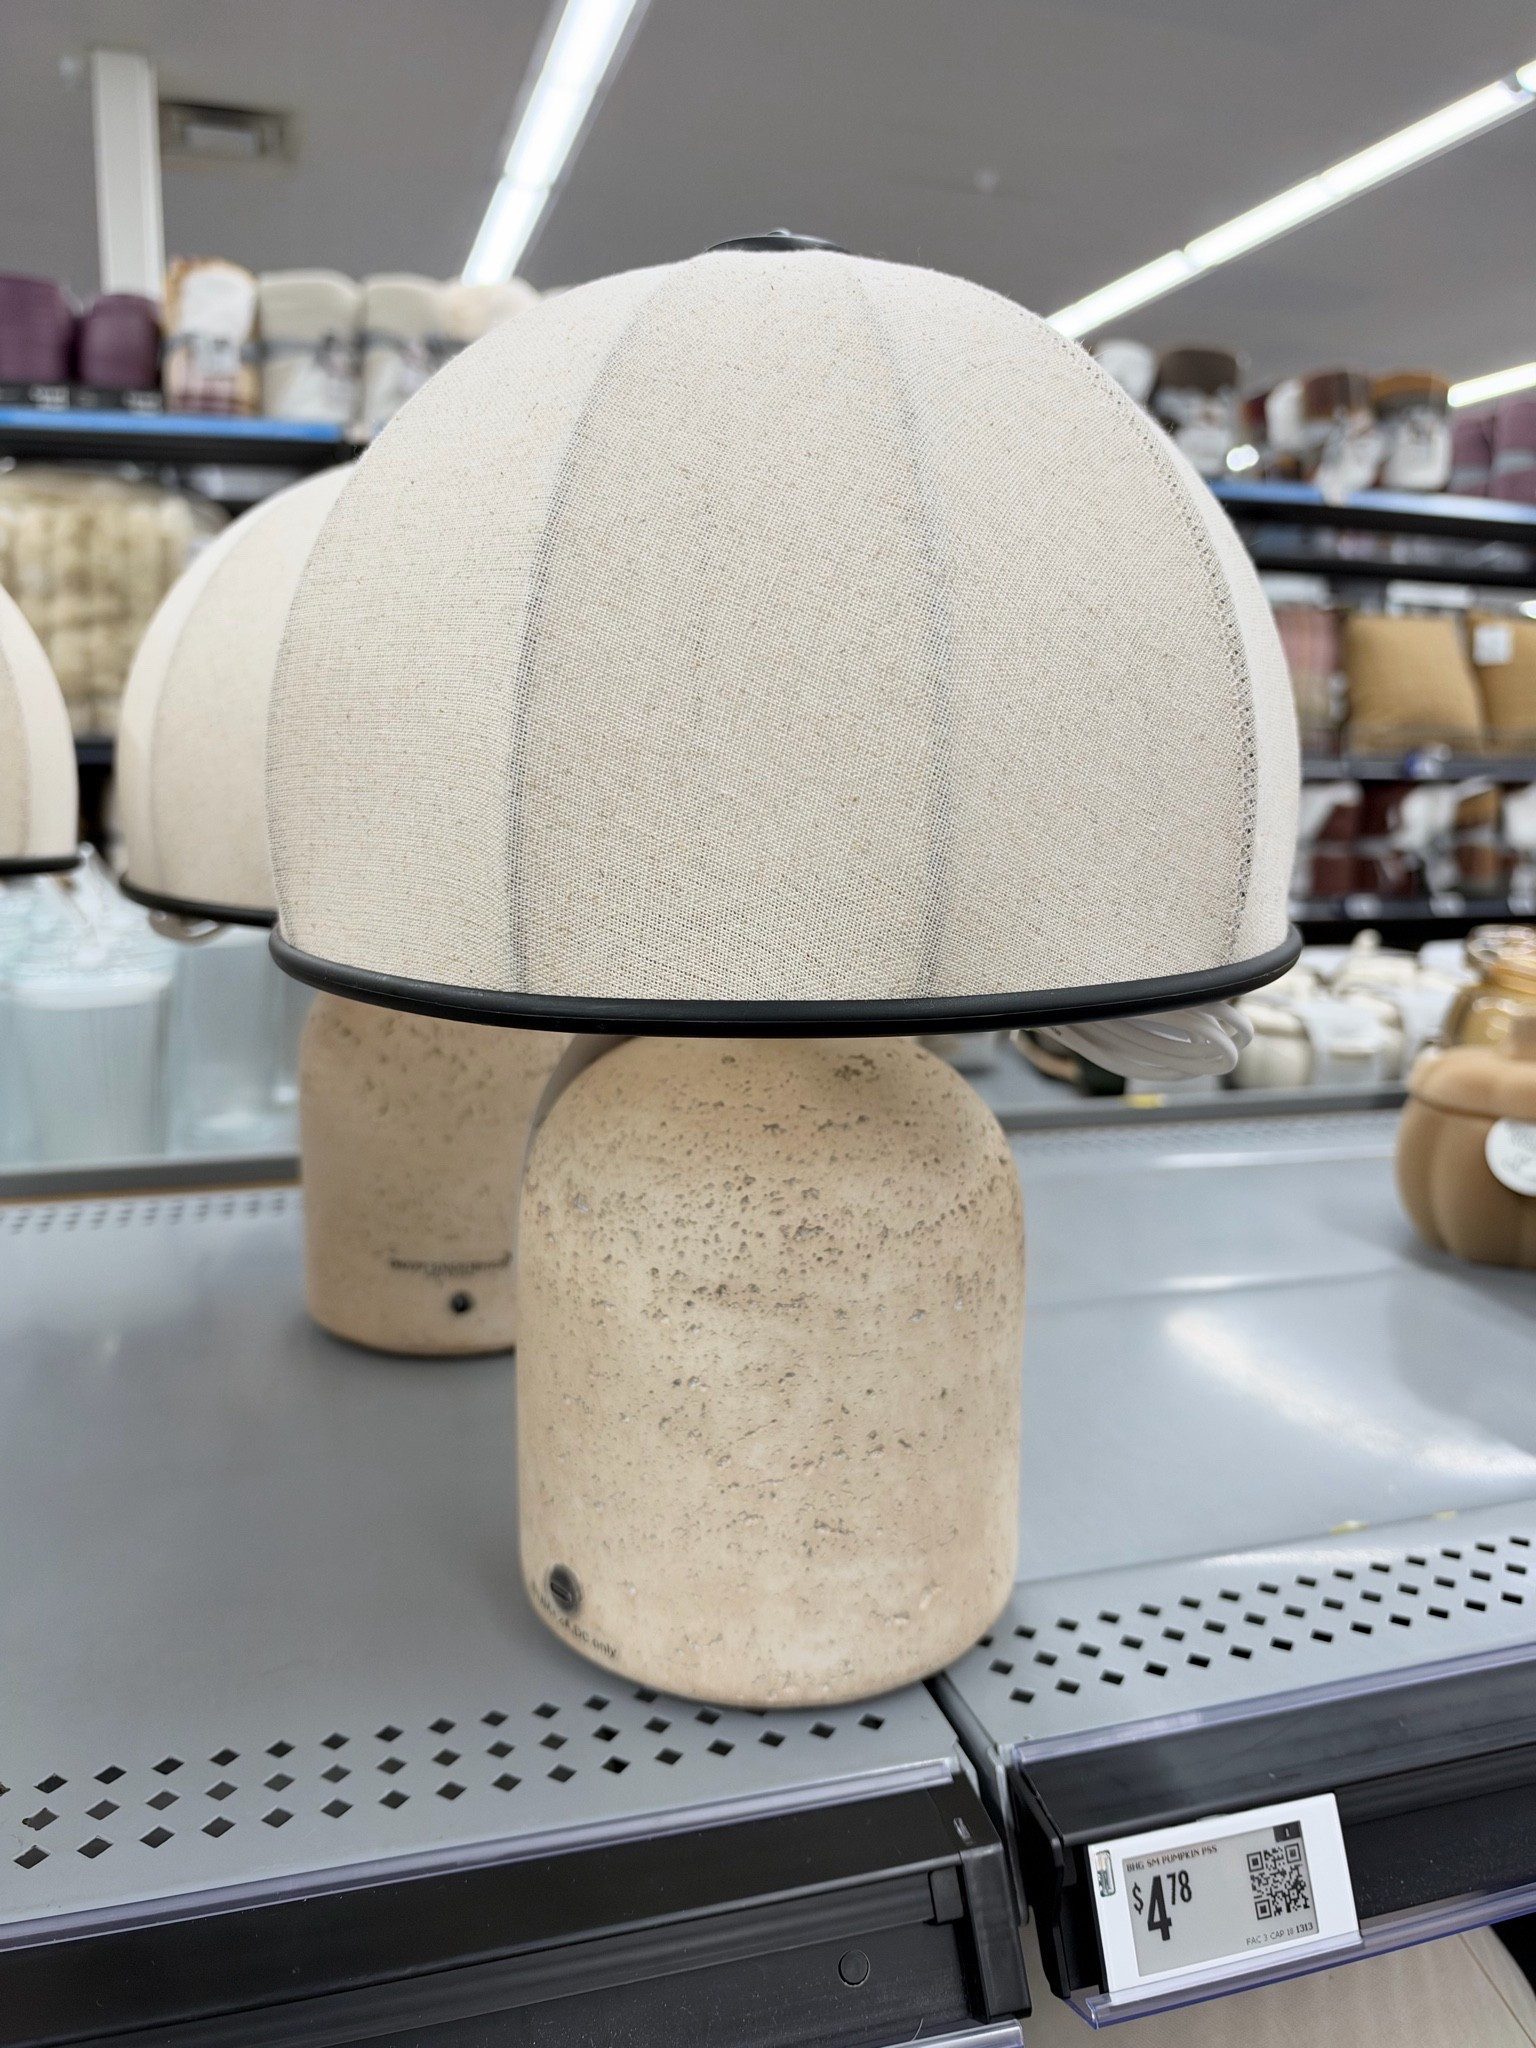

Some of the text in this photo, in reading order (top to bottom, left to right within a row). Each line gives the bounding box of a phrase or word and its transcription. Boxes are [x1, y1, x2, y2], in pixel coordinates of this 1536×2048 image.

[592, 1638, 617, 1658] only
[1126, 1844, 1218, 1873] BHG SM PUMPKIN PSS
[1246, 1934, 1262, 1946] FAC
[1269, 1929, 1285, 1940] CAP
[1295, 1922, 1314, 1934] 1313
